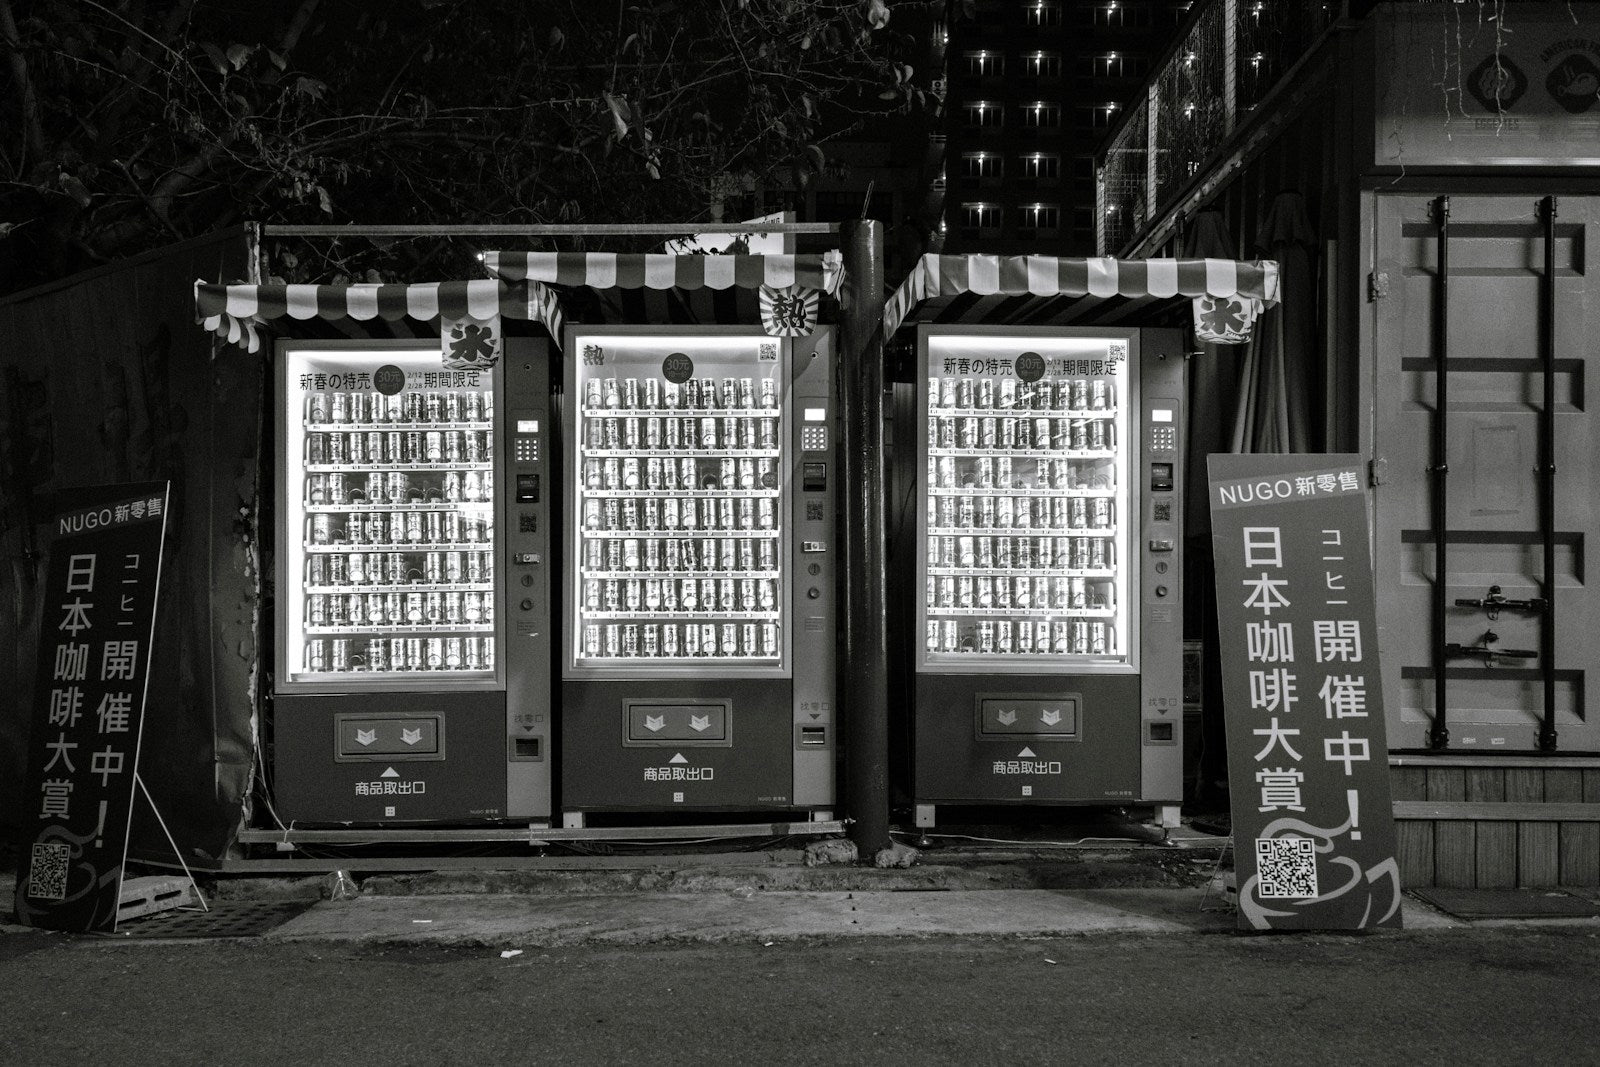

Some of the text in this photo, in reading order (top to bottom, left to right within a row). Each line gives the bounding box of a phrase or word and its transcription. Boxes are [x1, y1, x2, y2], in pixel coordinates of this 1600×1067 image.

[771, 294, 807, 329] 熱
[666, 359, 689, 371] 30元
[943, 357, 1013, 376] 新春の特売
[1062, 358, 1117, 376] 期間限定
[300, 373, 371, 391] 新春の特売
[424, 371, 481, 389] 期間限定
[1219, 470, 1359, 505] NUGO 新零售
[59, 497, 163, 535] NUGO 新零售
[1242, 526, 1307, 813] 日本咖啡大賞
[38, 553, 97, 821] 日本咖啡大賞
[643, 767, 714, 781] 商品取出口
[992, 760, 1062, 775] 商品取出口
[355, 781, 426, 796] 商品取出口
